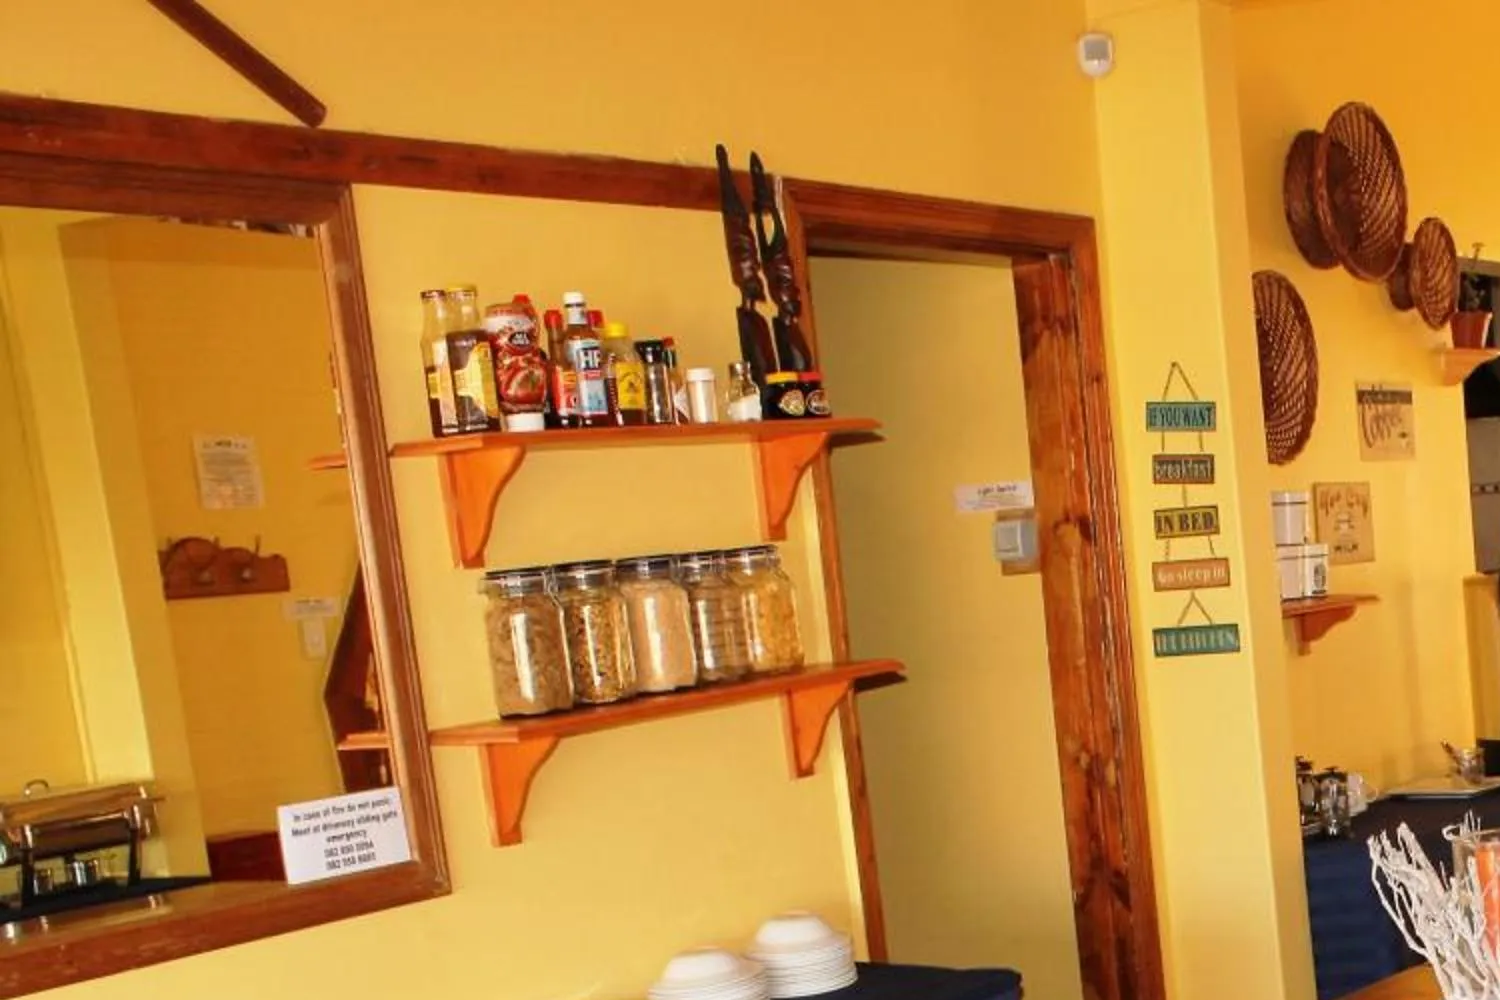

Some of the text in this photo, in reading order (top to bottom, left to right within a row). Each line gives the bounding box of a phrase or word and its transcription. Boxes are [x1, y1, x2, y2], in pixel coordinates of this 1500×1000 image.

[1159, 406, 1180, 427] YOU
[1181, 405, 1212, 427] WANT
[1155, 458, 1211, 481] breakfast
[1156, 515, 1173, 533] IN
[1176, 567, 1211, 585] sleep
[326, 829, 367, 842] emergency
